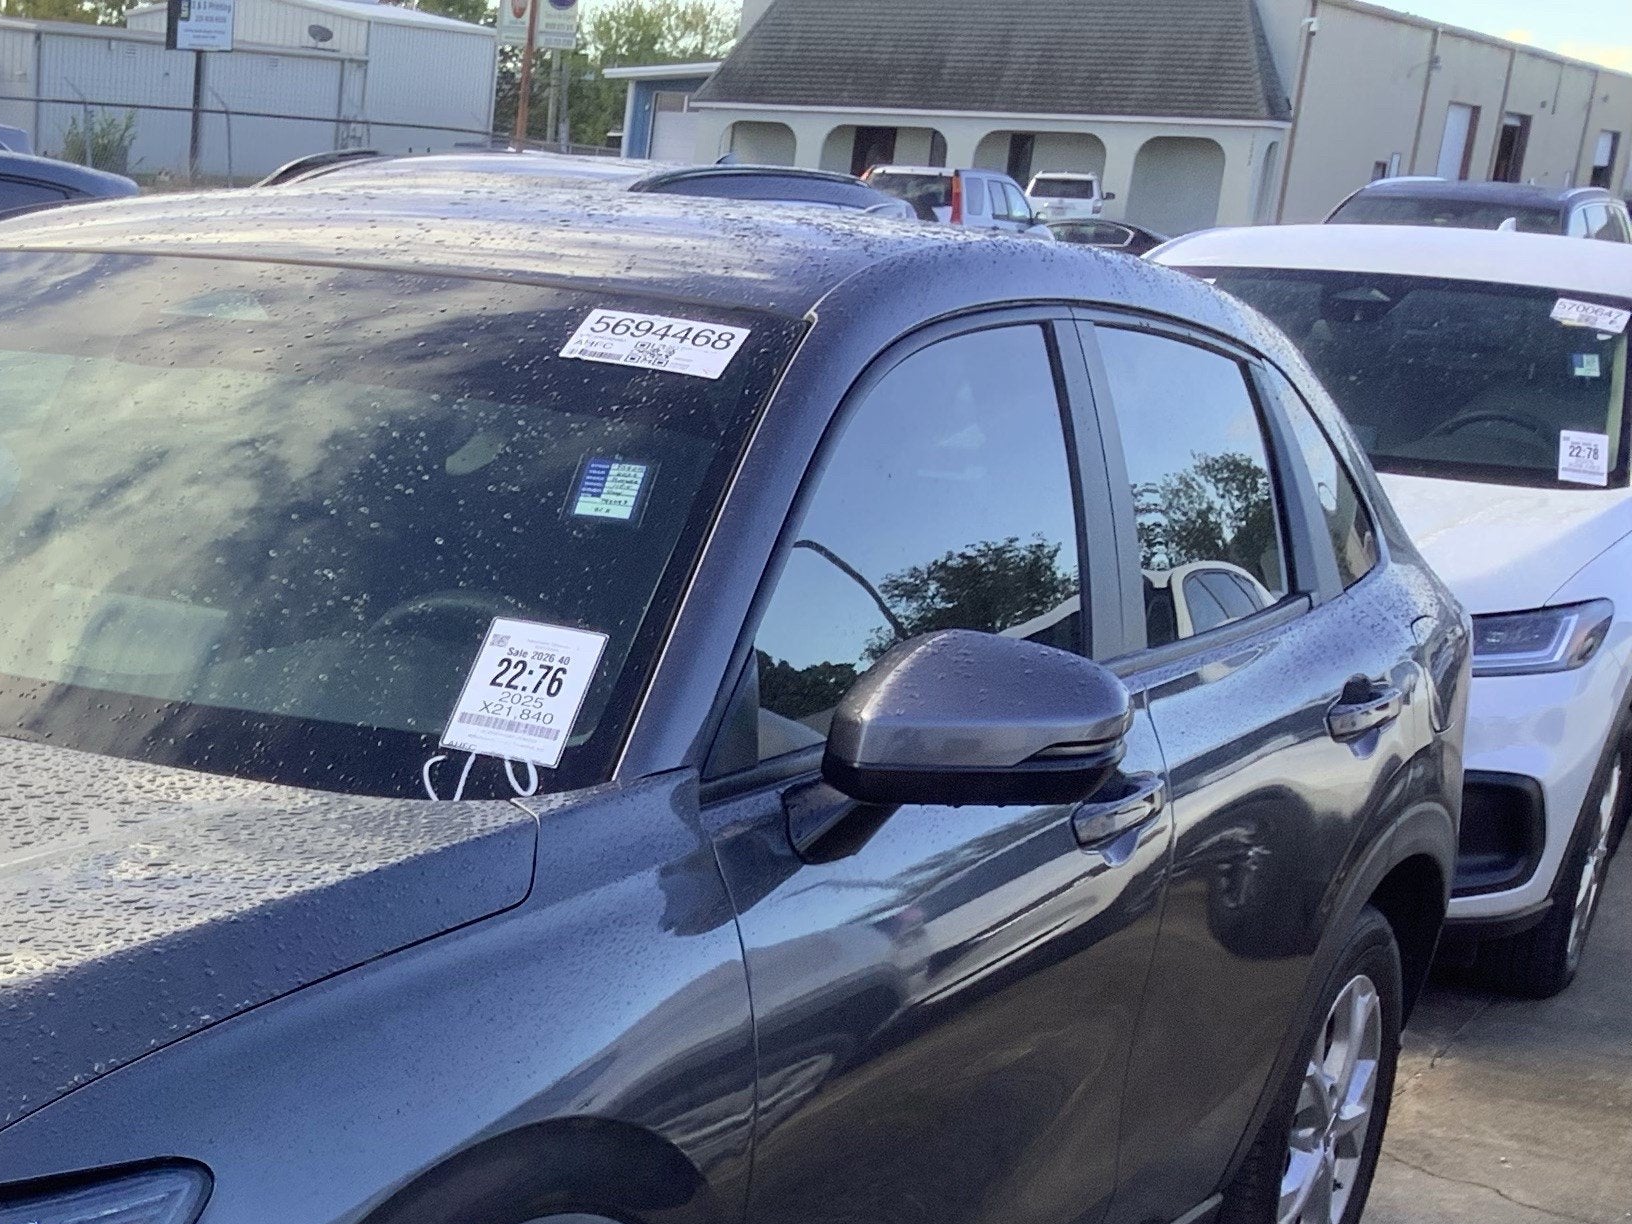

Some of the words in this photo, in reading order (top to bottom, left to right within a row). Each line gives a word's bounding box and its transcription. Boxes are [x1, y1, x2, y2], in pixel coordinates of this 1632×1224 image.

[590, 315, 736, 350] 5694468
[507, 647, 528, 659] Sale
[530, 651, 556, 663] 2026
[489, 657, 568, 698] 22:76
[499, 691, 545, 709] 2025
